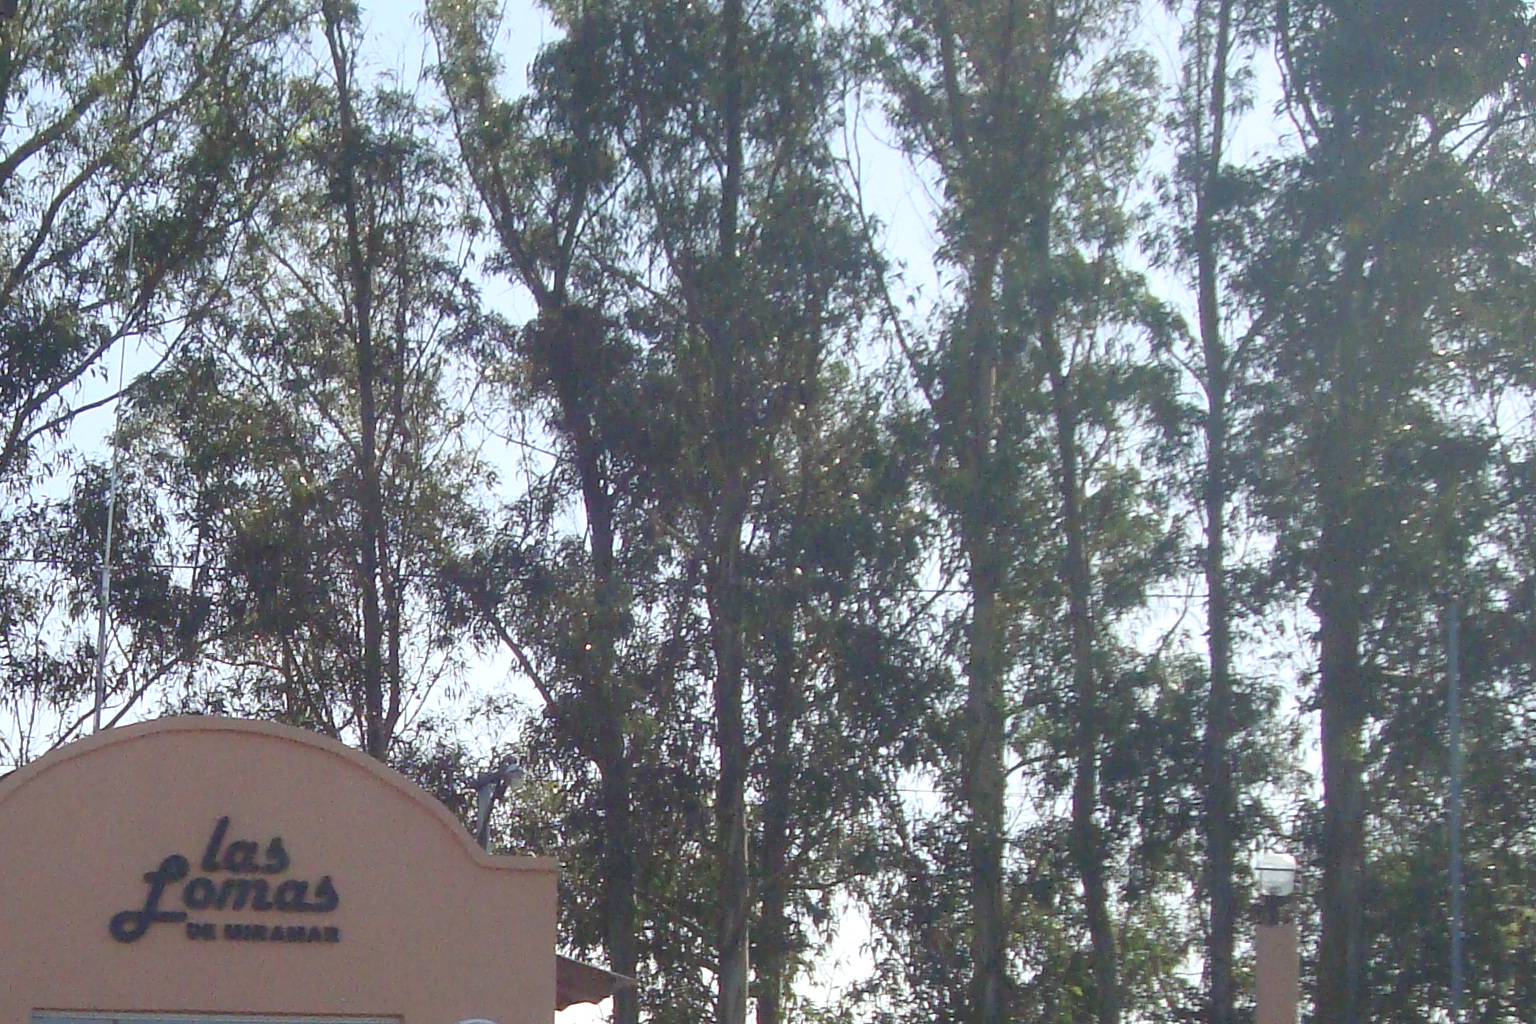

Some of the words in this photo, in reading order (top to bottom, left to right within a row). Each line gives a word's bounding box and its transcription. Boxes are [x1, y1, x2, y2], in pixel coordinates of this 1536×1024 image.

[109, 854, 340, 943] Lomas
[186, 922, 216, 940] DE
[224, 923, 340, 943] MIRAMAR
